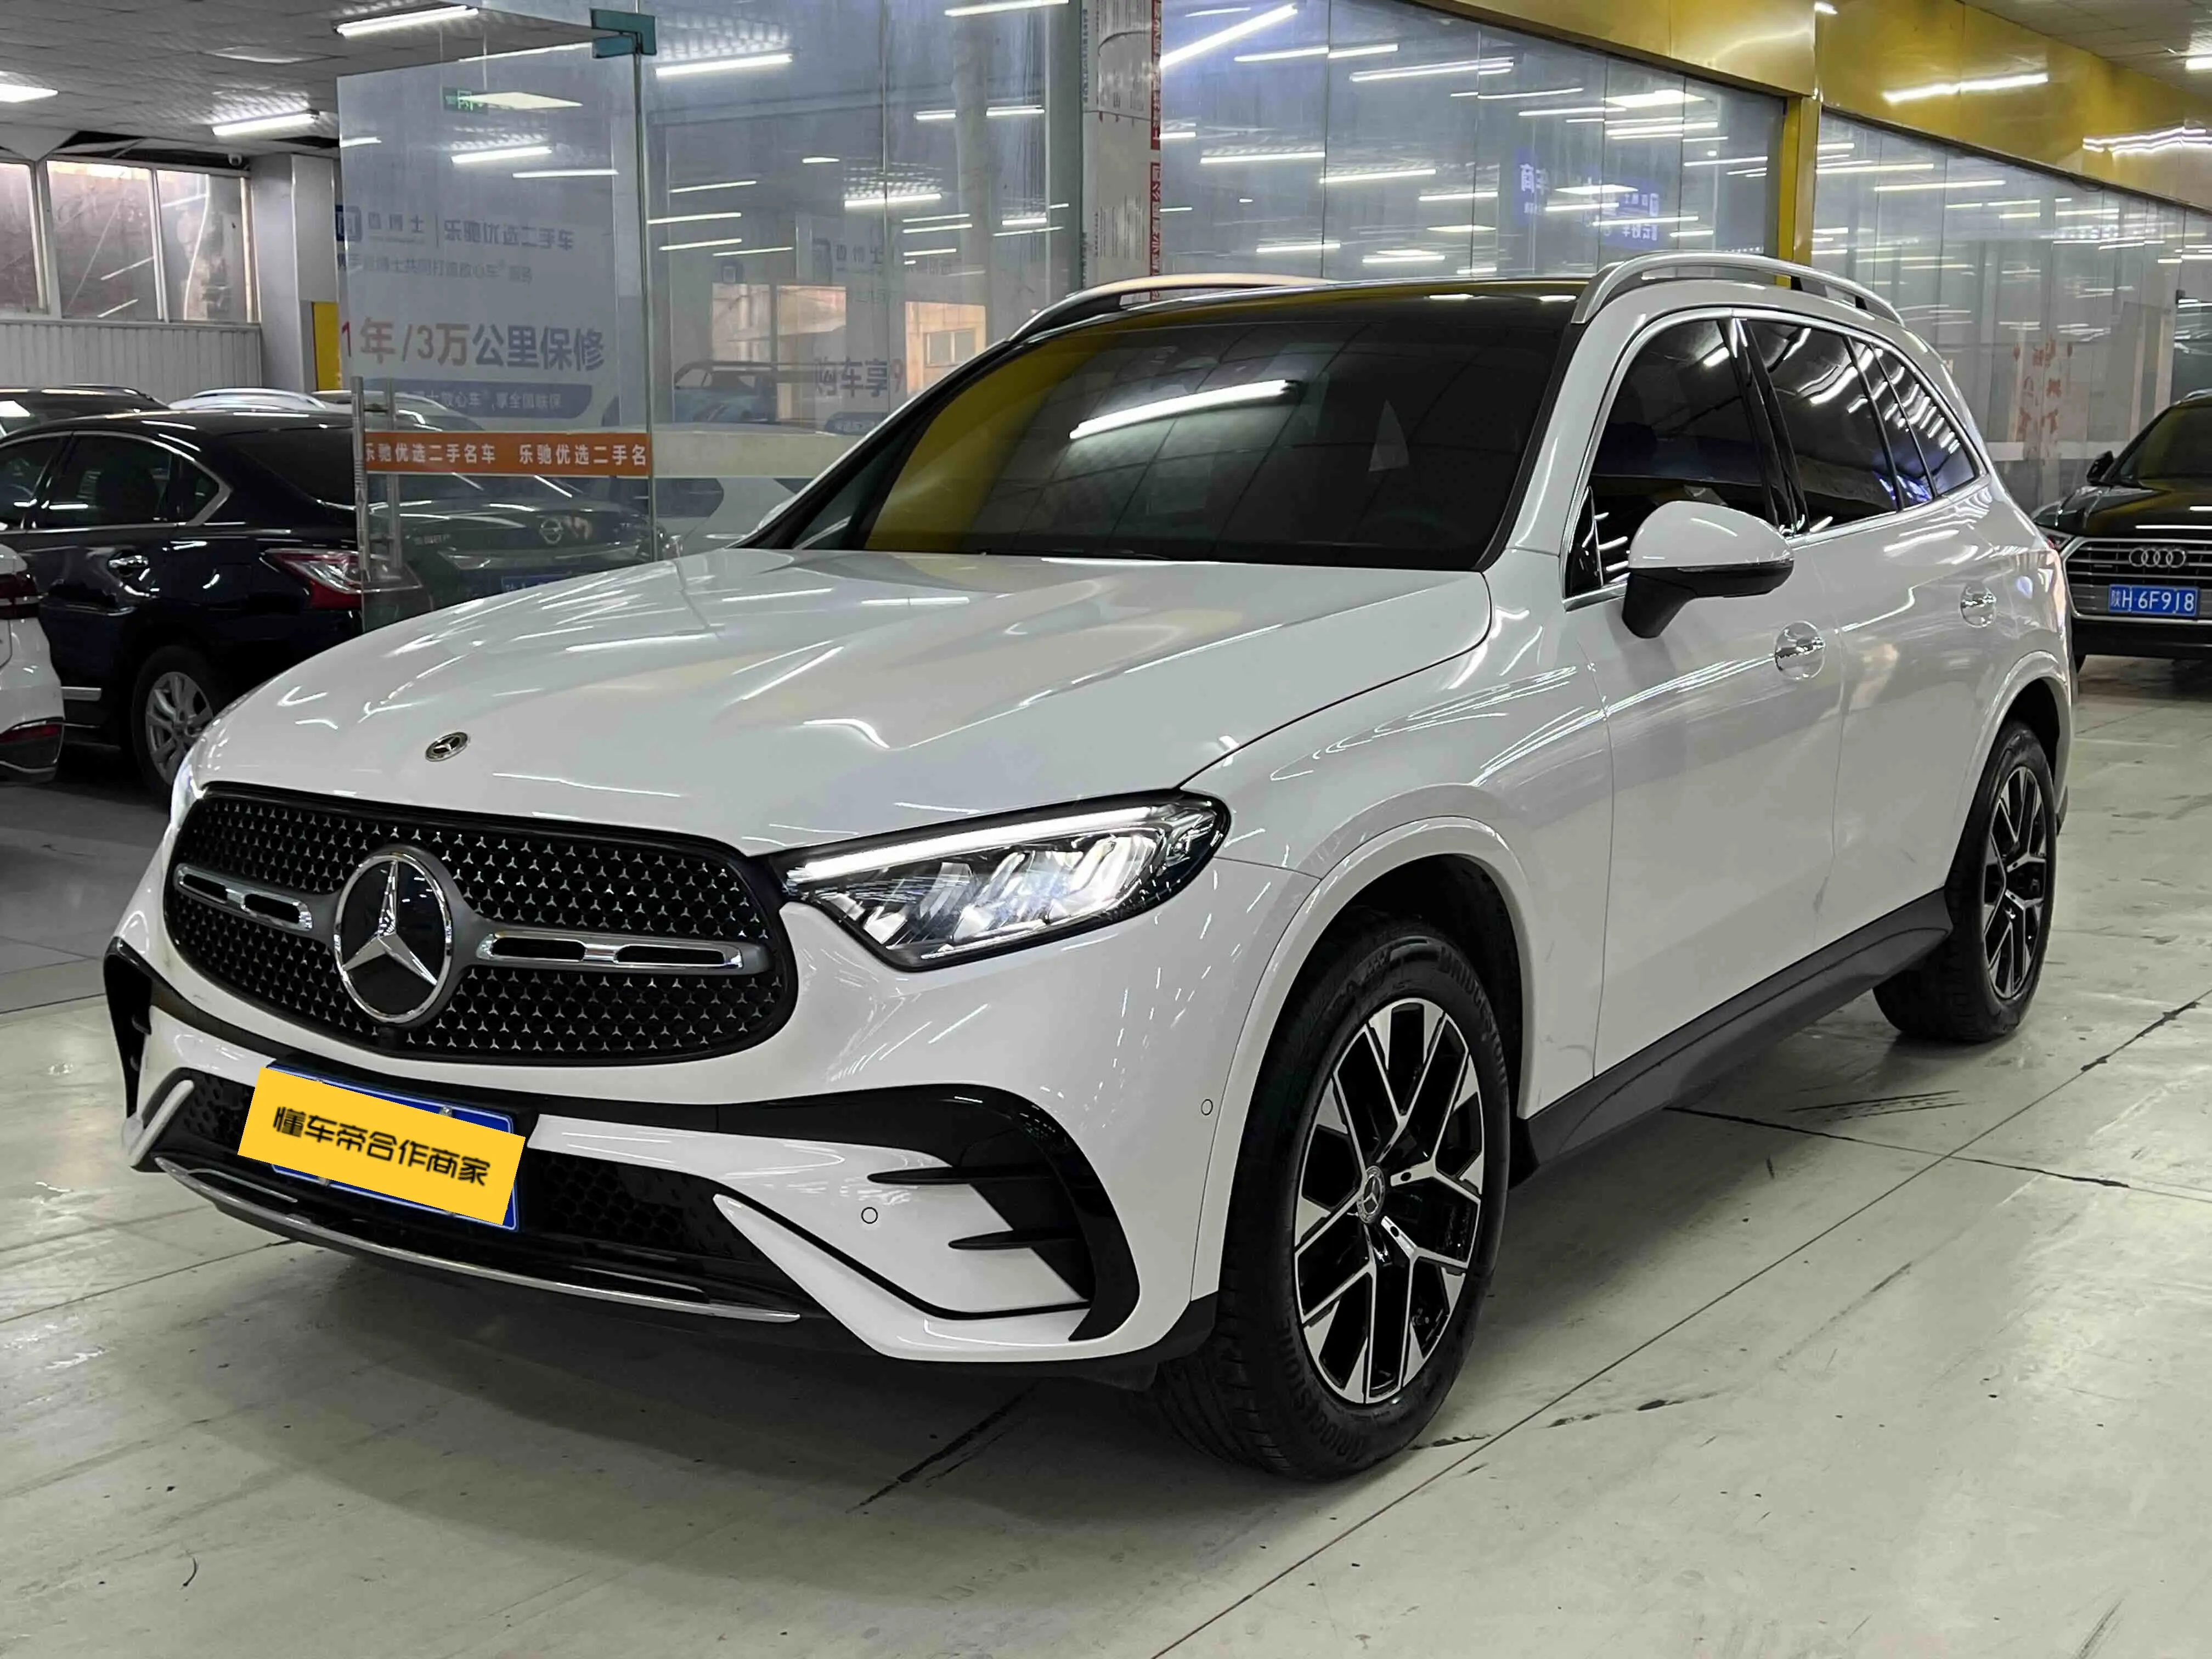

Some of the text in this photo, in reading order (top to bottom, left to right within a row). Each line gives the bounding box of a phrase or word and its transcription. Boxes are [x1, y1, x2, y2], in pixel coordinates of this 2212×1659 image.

[443, 218, 575, 251] 乐驰优选二手车
[341, 316, 606, 372] 1年/3万公里保修
[364, 441, 647, 467] 乐驰优选二手名车 乐驰优选二手名
